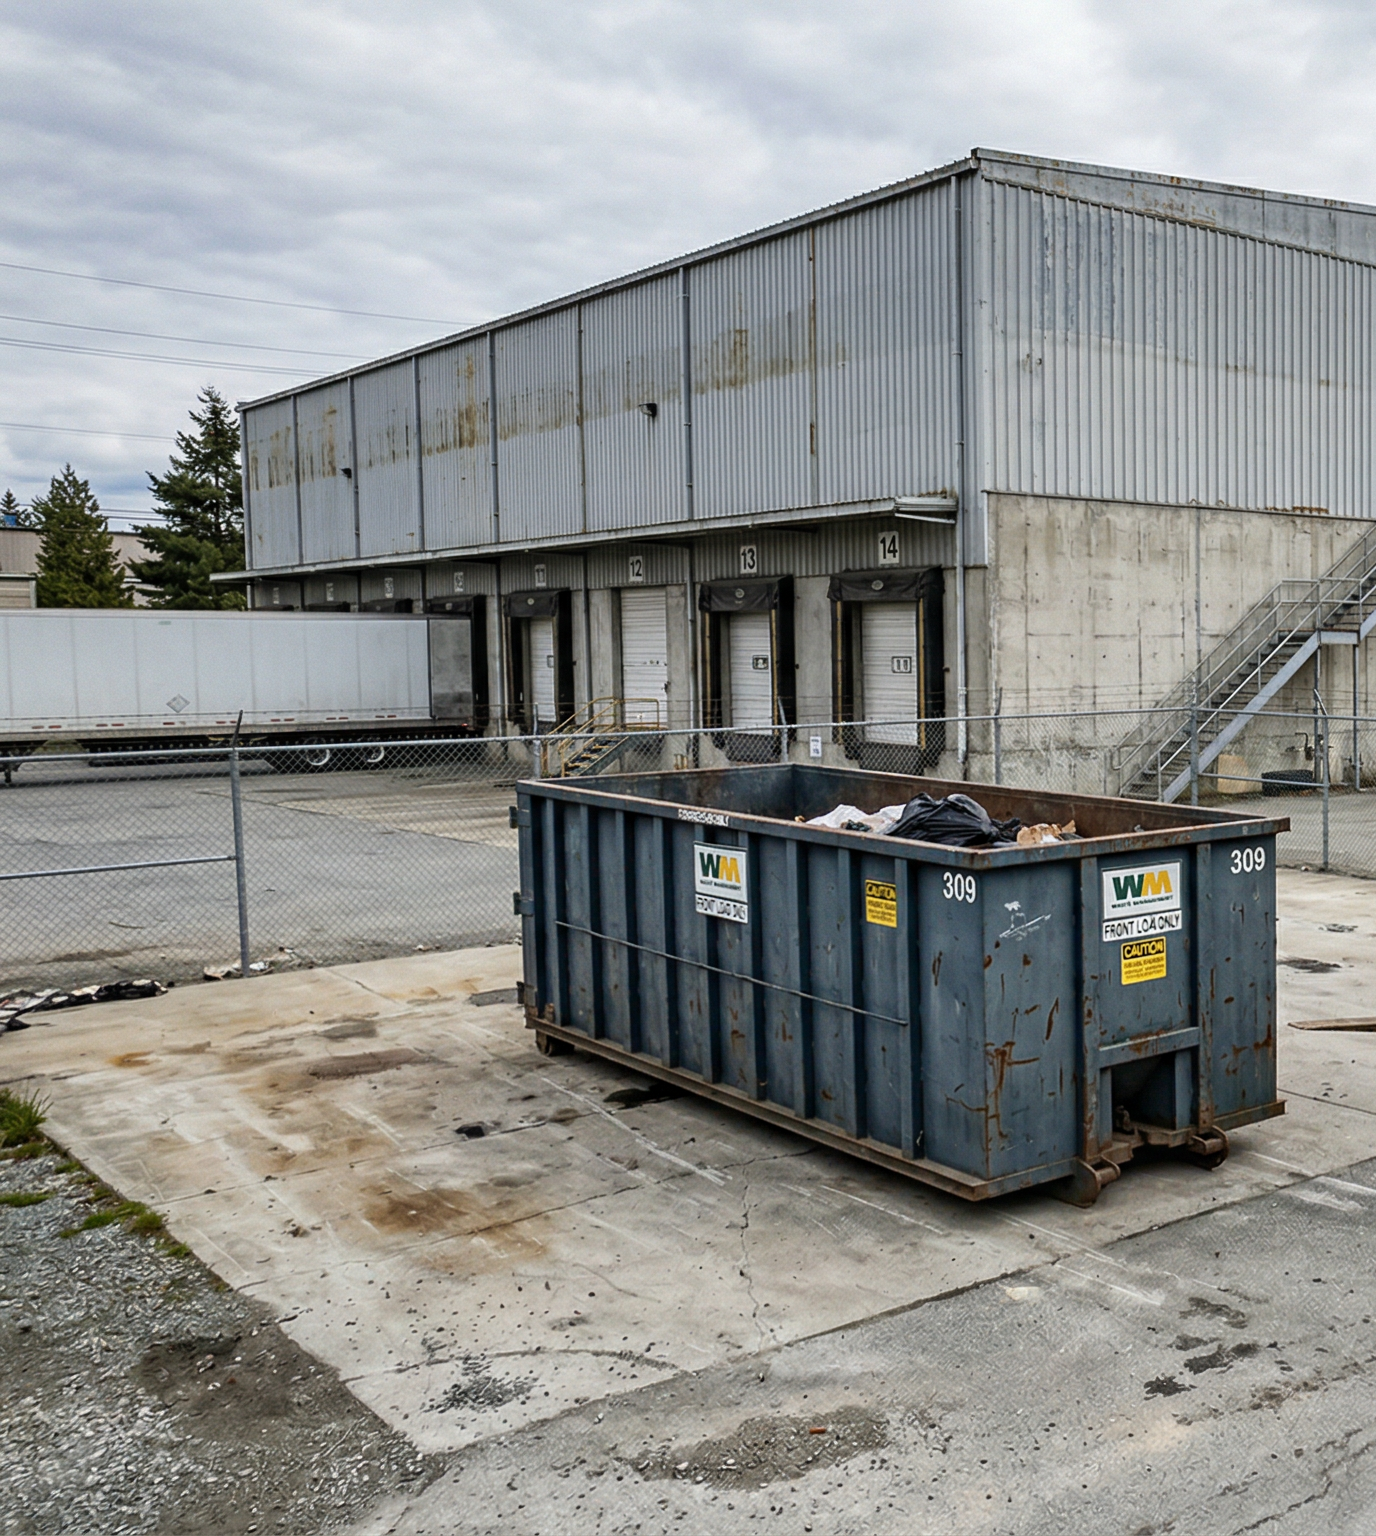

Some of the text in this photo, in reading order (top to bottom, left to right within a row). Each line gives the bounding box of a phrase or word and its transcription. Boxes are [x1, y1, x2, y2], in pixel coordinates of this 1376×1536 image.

[741, 548, 756, 570] 13
[880, 535, 898, 559] 14
[630, 559, 642, 577] 12
[699, 852, 741, 884] WM
[1230, 847, 1266, 874] 309
[943, 872, 976, 904] 309
[1112, 870, 1173, 901] WM
[1105, 920, 1134, 939] FRONT
[1124, 941, 1164, 958] CAUTION
